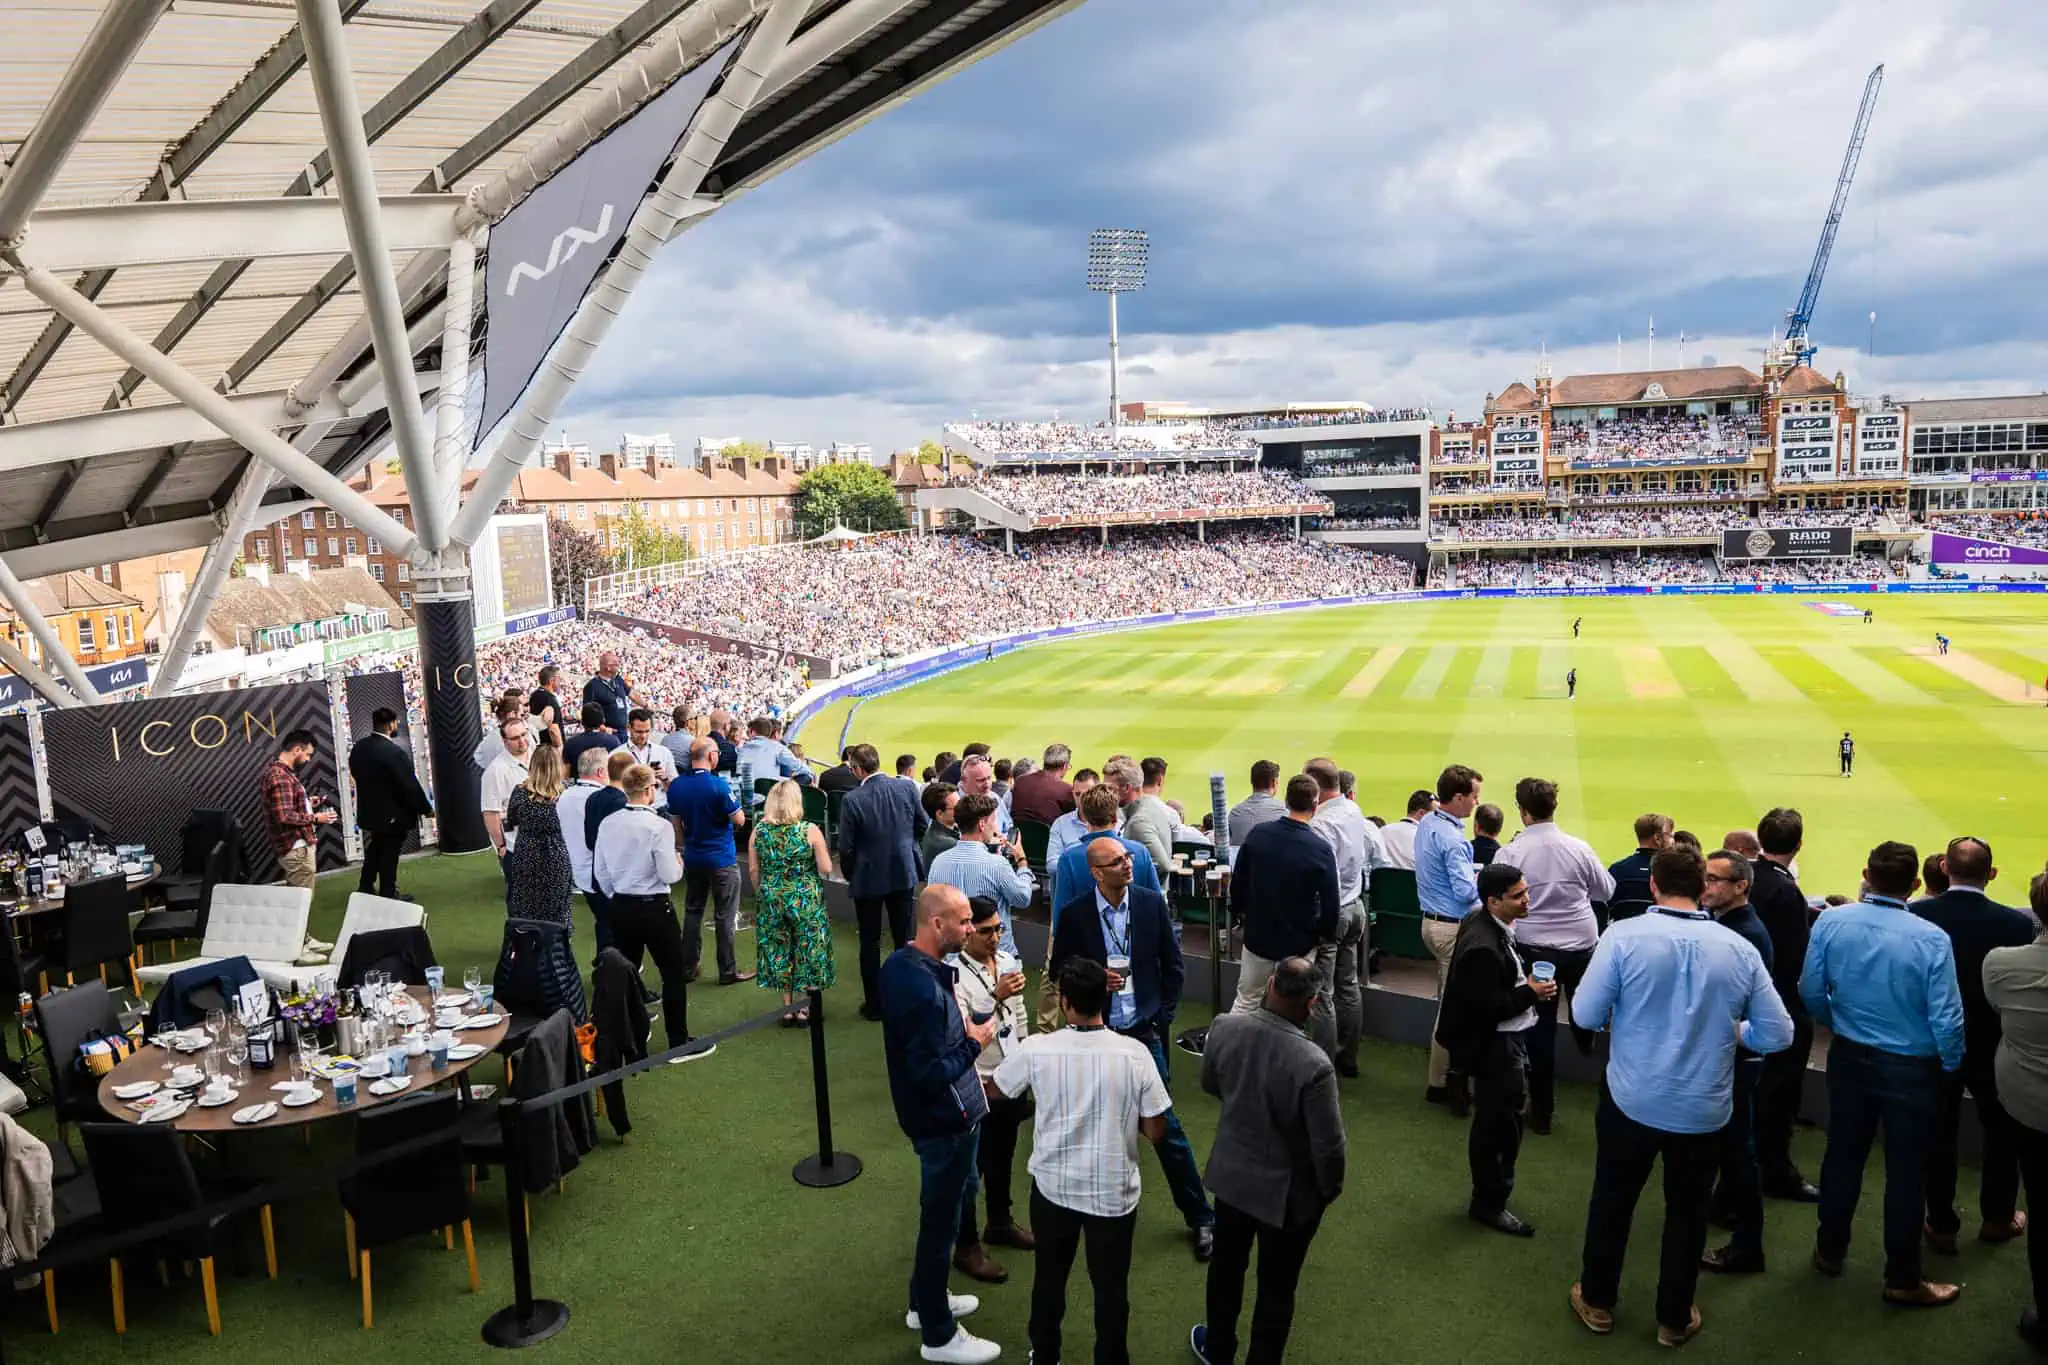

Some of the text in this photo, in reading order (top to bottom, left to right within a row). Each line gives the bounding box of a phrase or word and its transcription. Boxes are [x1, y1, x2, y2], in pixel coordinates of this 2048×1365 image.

[1793, 419, 1823, 428] KIA
[1504, 433, 1530, 441] KIA
[1792, 449, 1822, 457] KIA
[1504, 461, 1530, 469] KIA
[1789, 531, 1831, 540] RADO
[1965, 543, 2010, 558] cinch
[110, 668, 132, 684] KIA
[112, 708, 277, 761] ICON
